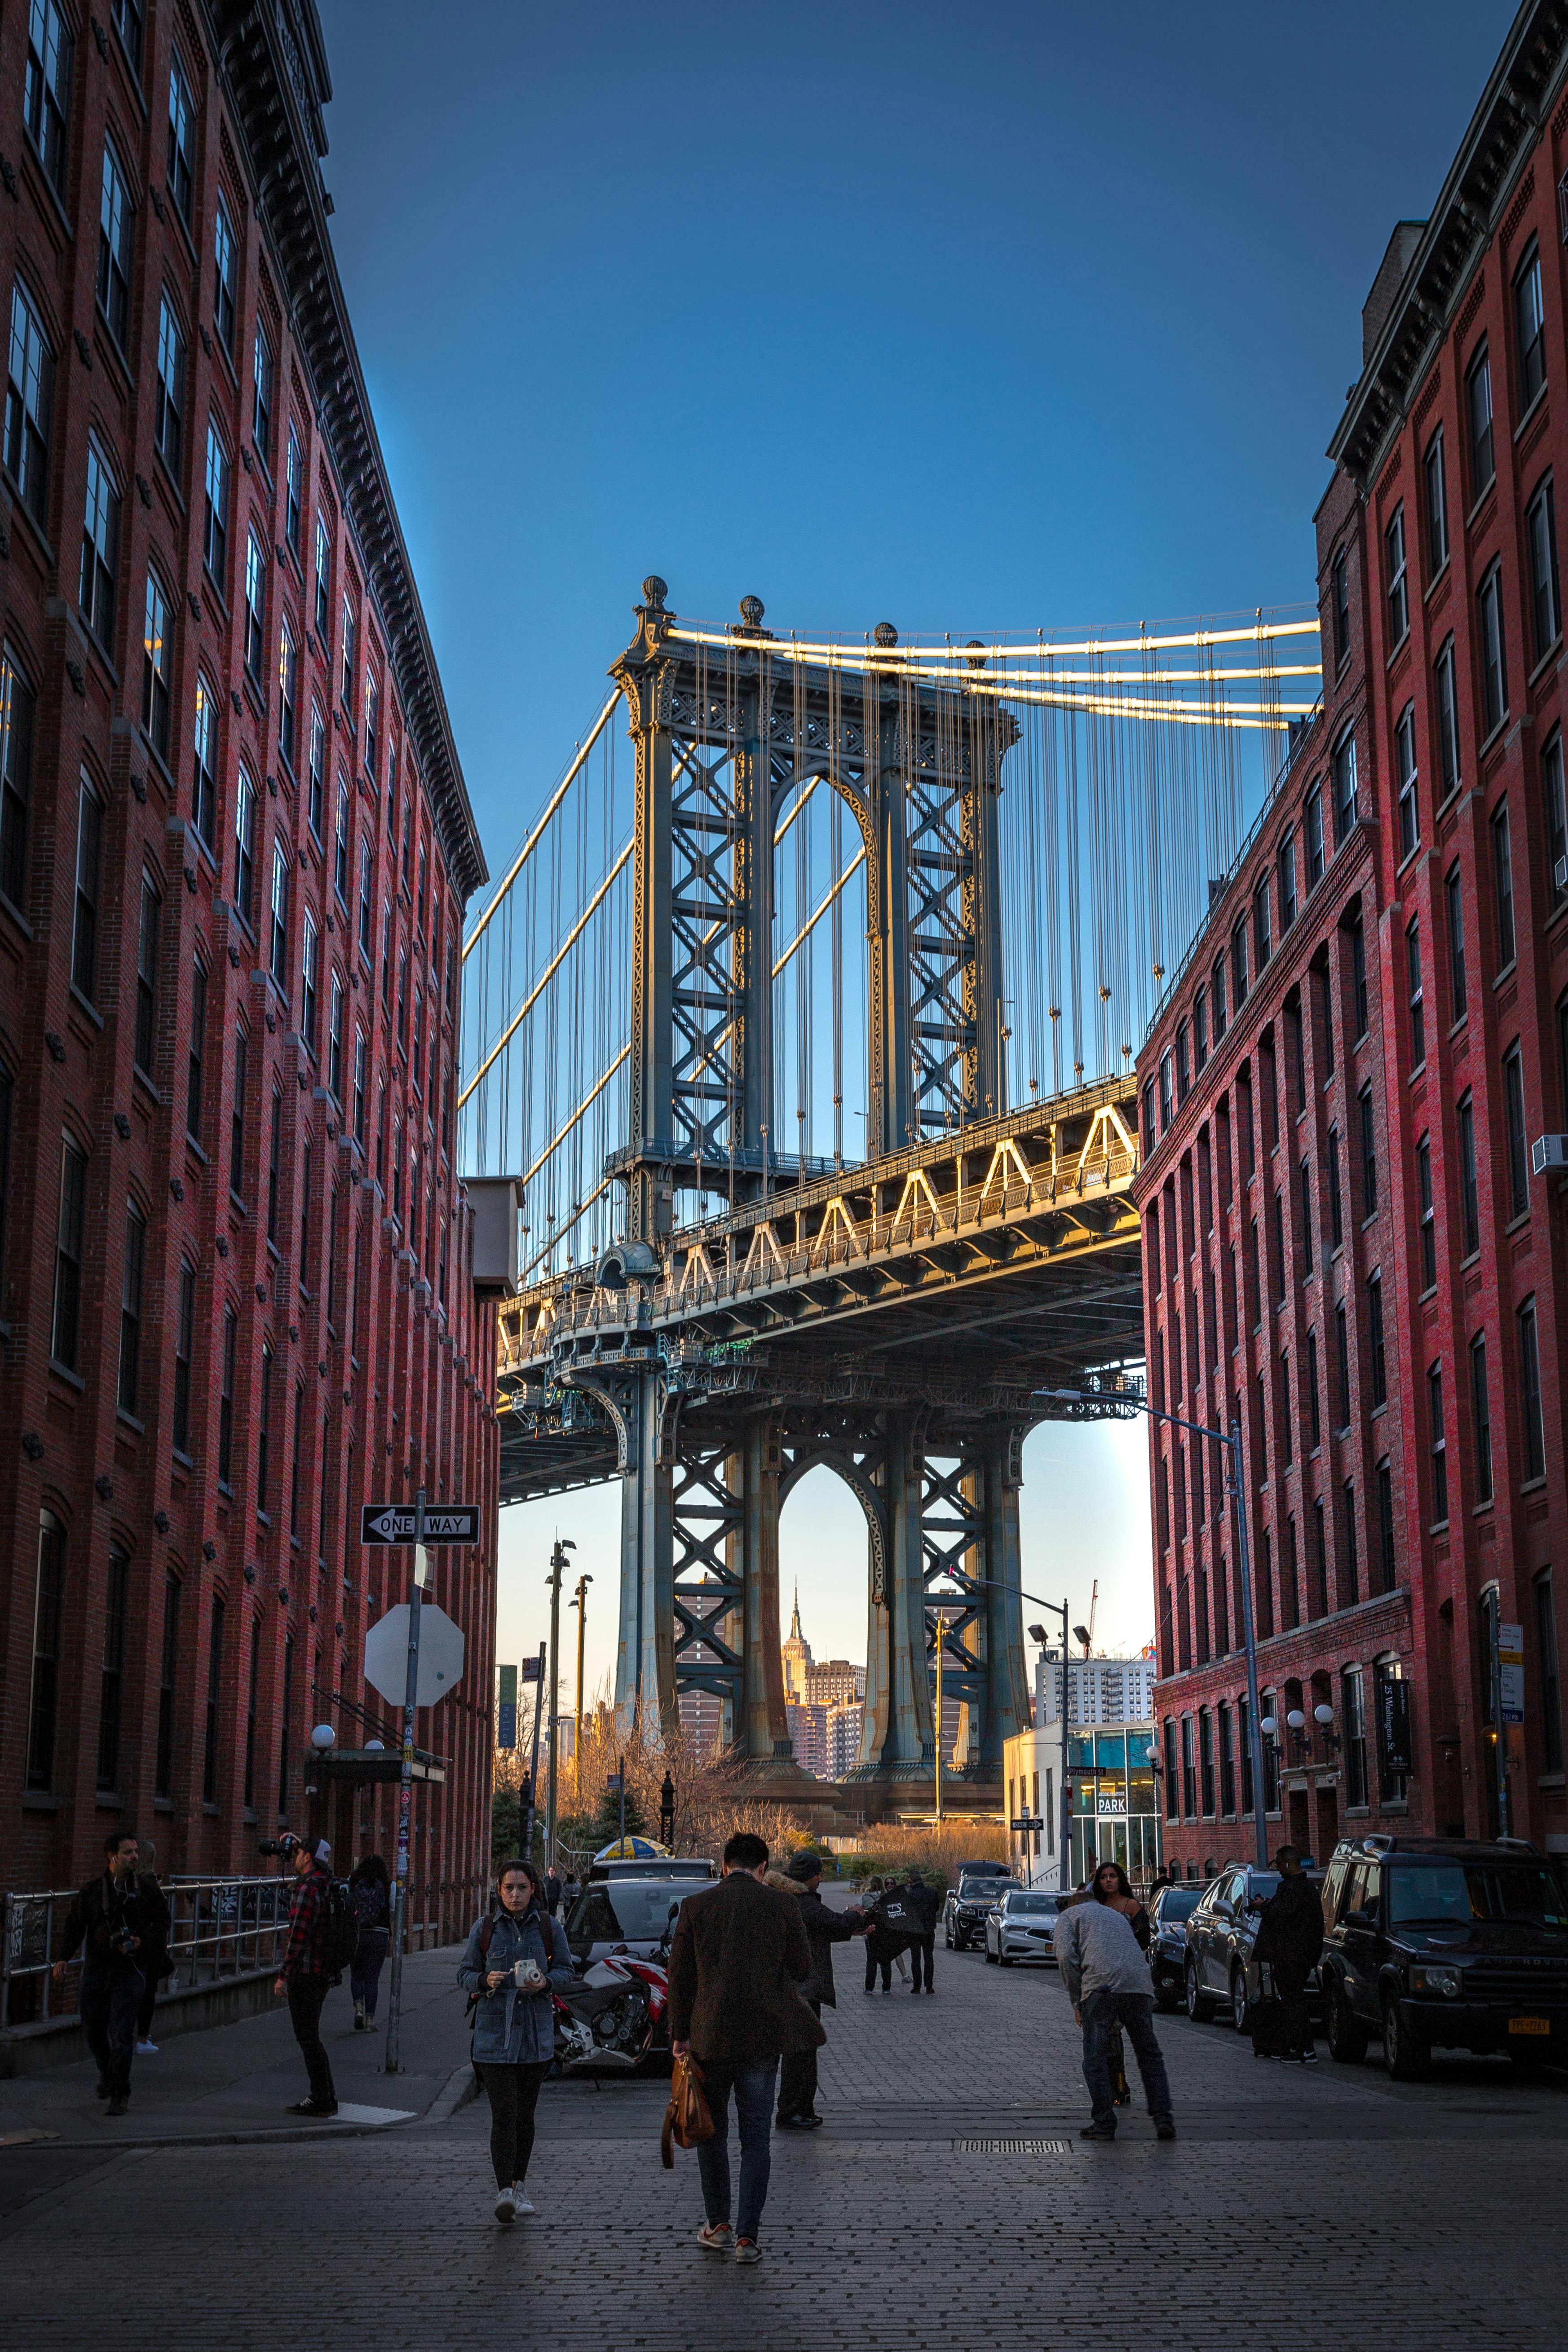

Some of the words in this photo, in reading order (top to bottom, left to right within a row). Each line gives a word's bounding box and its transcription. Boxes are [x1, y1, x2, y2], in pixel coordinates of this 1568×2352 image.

[381, 1518, 412, 1532] ONE
[429, 1518, 464, 1532] WAY
[1384, 1685, 1392, 1694] 25
[1384, 1696, 1394, 1740] Washington
[1387, 1742, 1395, 1752] St.
[1070, 1768, 1096, 1776] Plymouth
[1098, 1799, 1125, 1812] PARK
